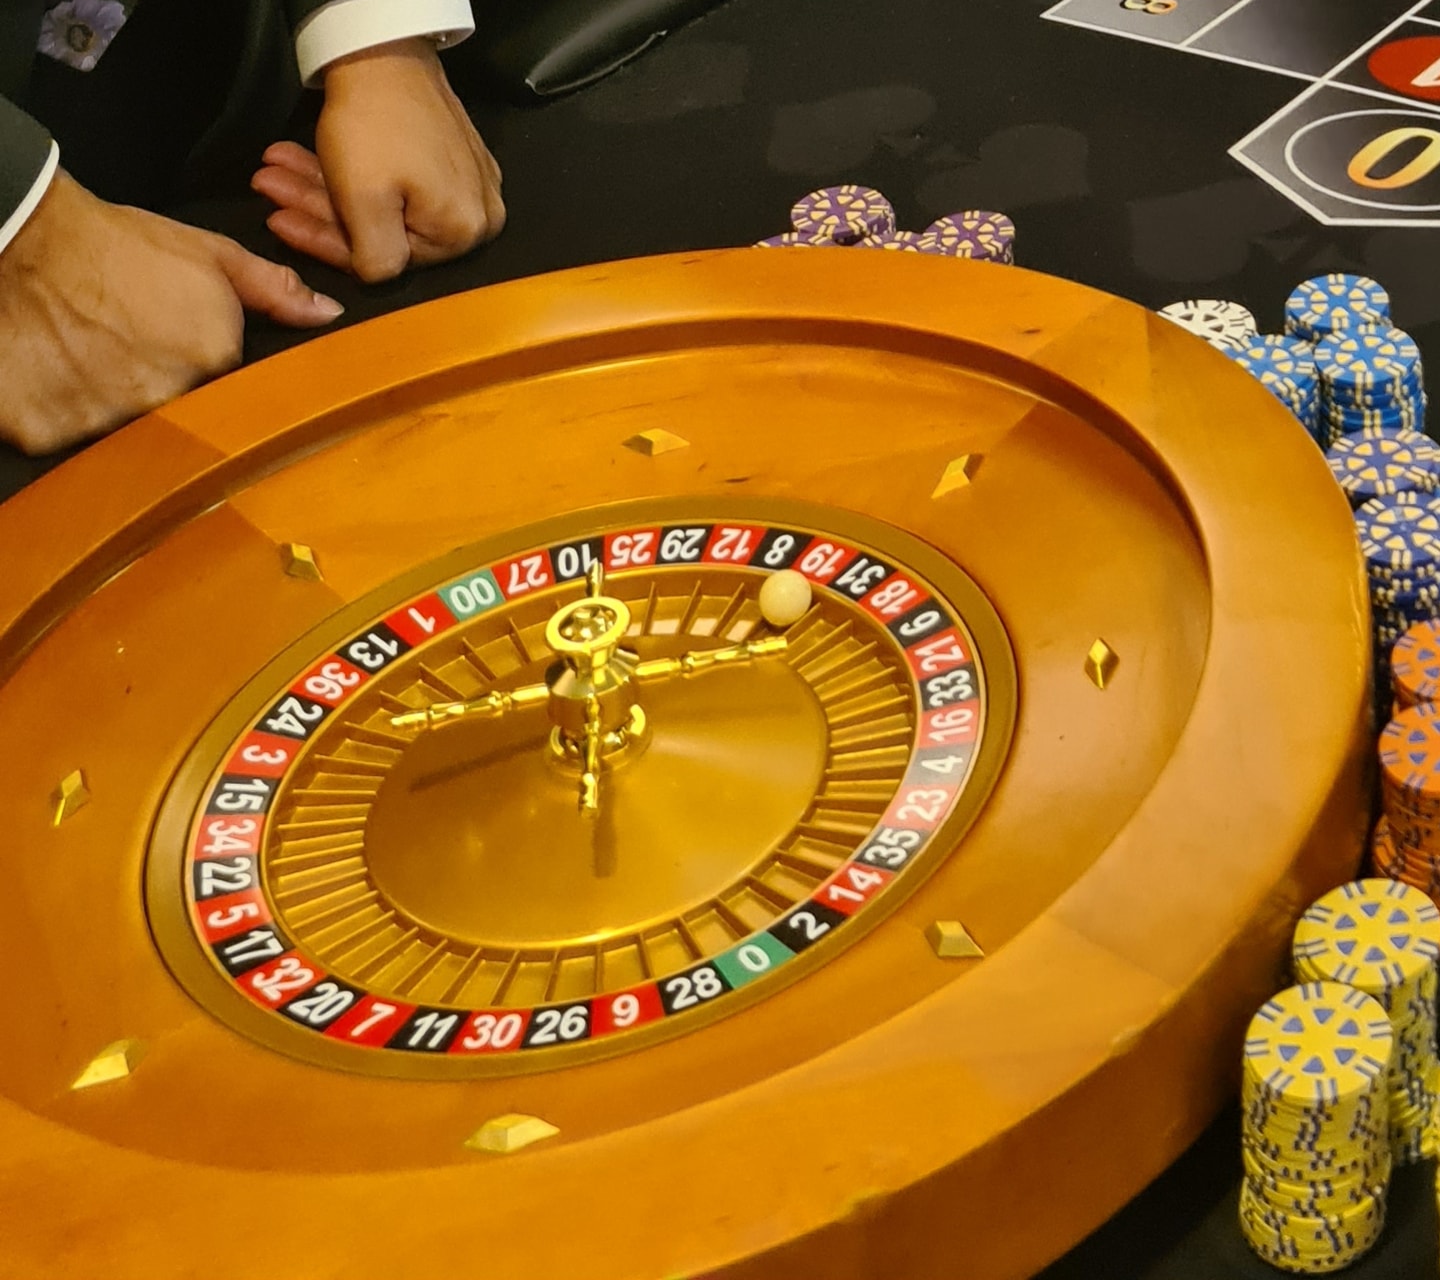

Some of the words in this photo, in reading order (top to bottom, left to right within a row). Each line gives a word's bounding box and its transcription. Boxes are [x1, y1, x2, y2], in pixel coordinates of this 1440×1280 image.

[556, 543, 600, 579] 10
[609, 531, 656, 567] 25
[660, 527, 708, 562] 29
[710, 526, 754, 562] 12
[763, 533, 796, 567] 8
[800, 542, 846, 578] 19
[506, 554, 550, 596] 27
[834, 556, 887, 596] 31
[449, 576, 497, 614] 00
[869, 579, 918, 616] 18
[407, 606, 437, 634] 1
[898, 609, 942, 637] 6
[348, 632, 399, 669] 13
[913, 633, 965, 673] 21
[304, 661, 361, 701] 36
[926, 668, 974, 708] 33
[265, 696, 324, 737] 24
[928, 707, 974, 743] 16
[241, 744, 288, 765] 3
[920, 754, 965, 775] 4
[215, 778, 270, 811] 15
[896, 788, 949, 823] 23
[202, 818, 257, 855] 34
[863, 827, 922, 866] 35
[200, 856, 252, 897] 22
[827, 866, 884, 903] 14
[206, 901, 260, 928] 5
[788, 911, 832, 941] 2
[223, 929, 285, 965] 17
[737, 943, 772, 973] 0
[251, 957, 315, 1002] 32
[665, 966, 723, 1011] 28
[286, 981, 355, 1025] 20
[350, 1001, 398, 1038] 7
[610, 993, 641, 1028] 9
[407, 1011, 459, 1049] 11
[462, 1012, 523, 1050] 30
[528, 1004, 590, 1046] 26
